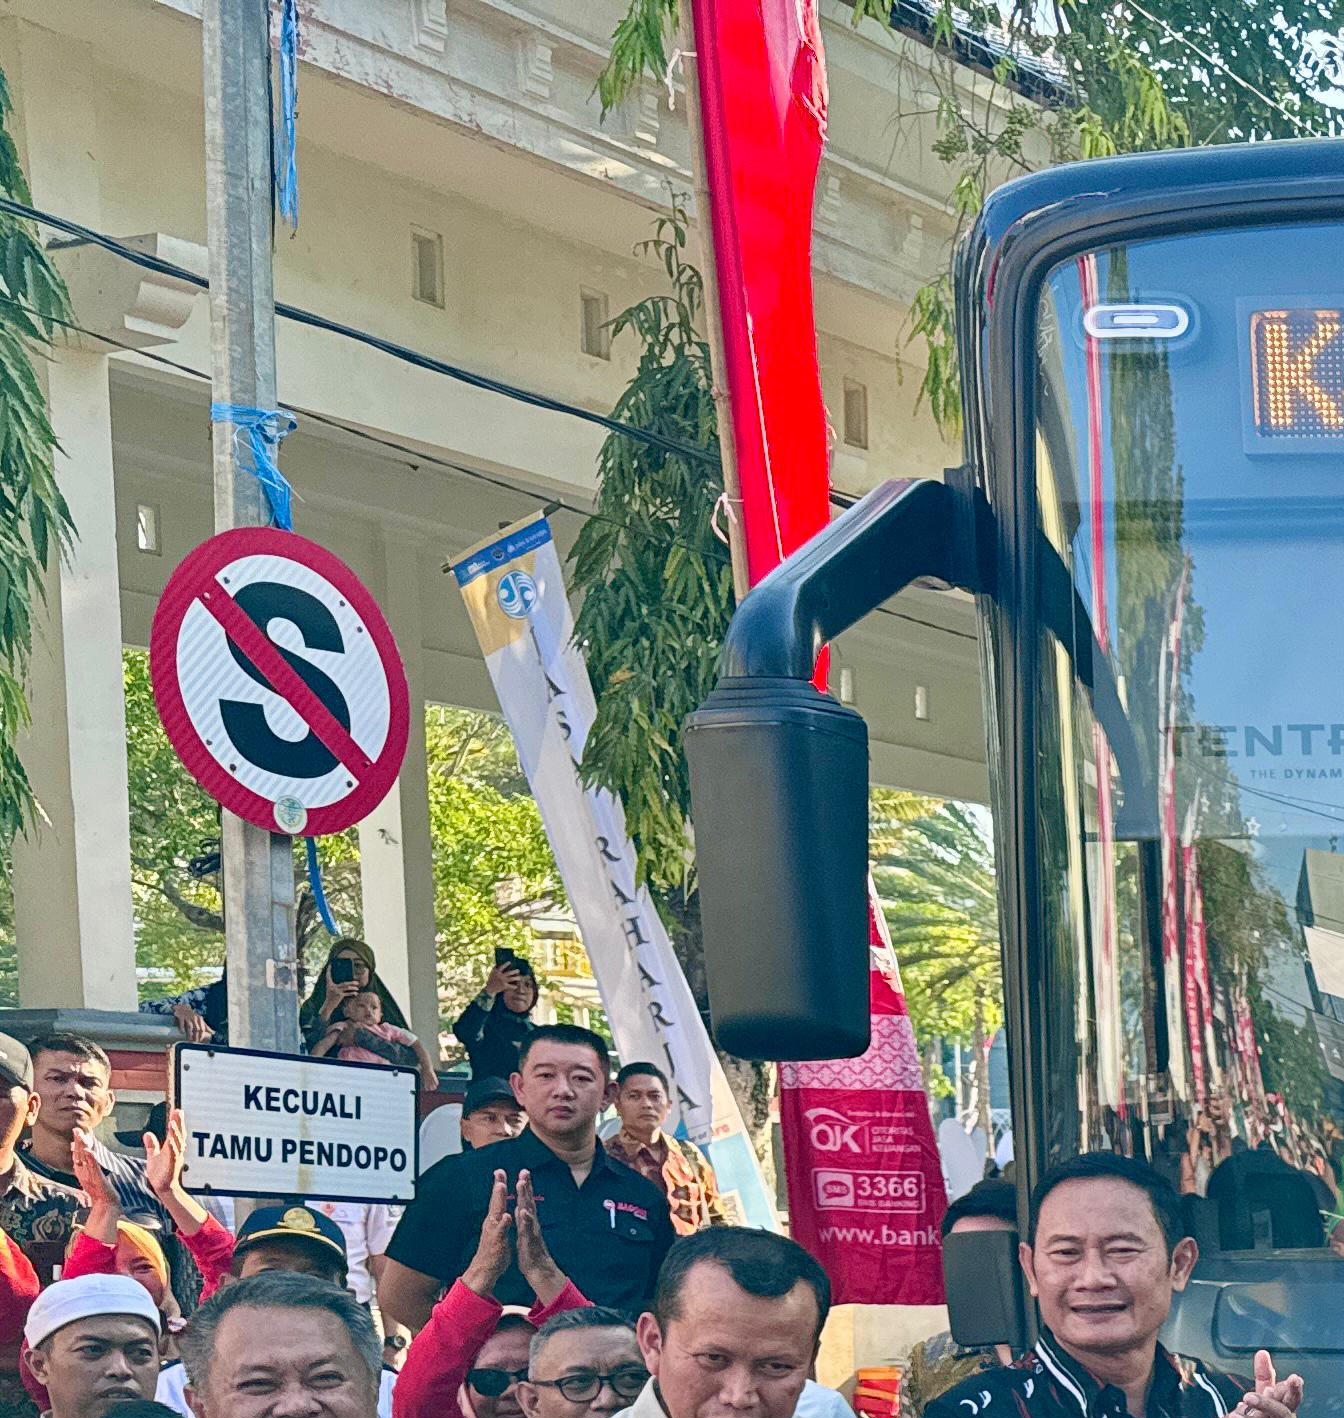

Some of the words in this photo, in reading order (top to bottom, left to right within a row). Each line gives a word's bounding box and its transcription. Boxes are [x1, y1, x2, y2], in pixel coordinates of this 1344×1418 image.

[1249, 768, 1277, 780] THE
[244, 1084, 362, 1120] KECUALI
[192, 1131, 273, 1162] TAMU
[281, 1138, 407, 1172] PENDOPO
[856, 1175, 919, 1198] 3366
[818, 1225, 944, 1249] www.bank
